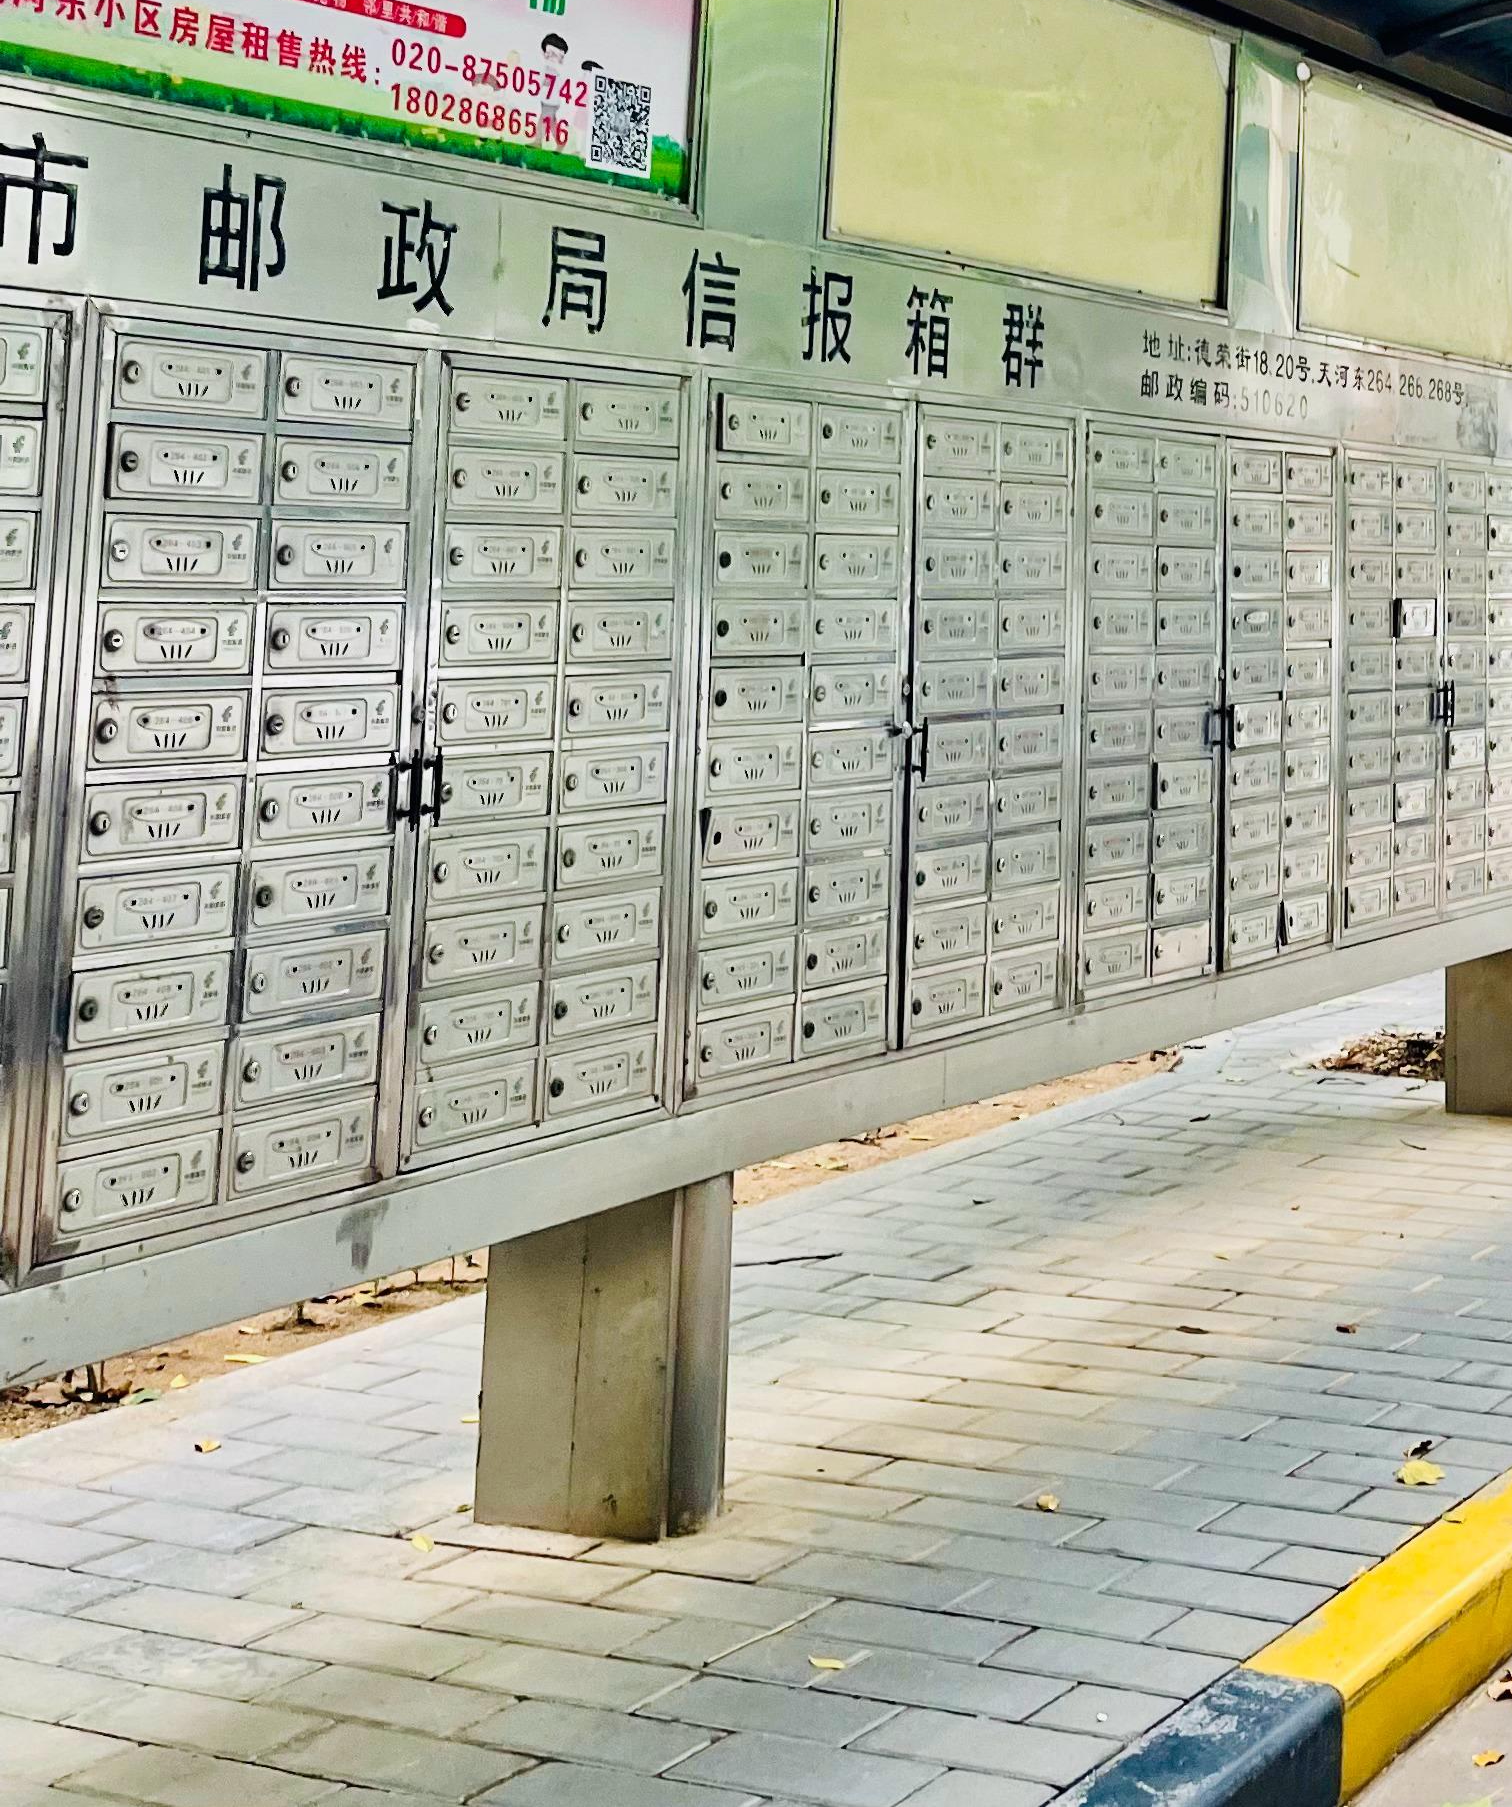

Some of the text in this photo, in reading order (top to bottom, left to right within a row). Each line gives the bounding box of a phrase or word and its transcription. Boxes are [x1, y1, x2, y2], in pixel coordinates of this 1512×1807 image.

[391, 38, 588, 108] 020-87505742
[391, 83, 569, 146] 18028686516
[0, 132, 1045, 389] 市邮政局信报箱群
